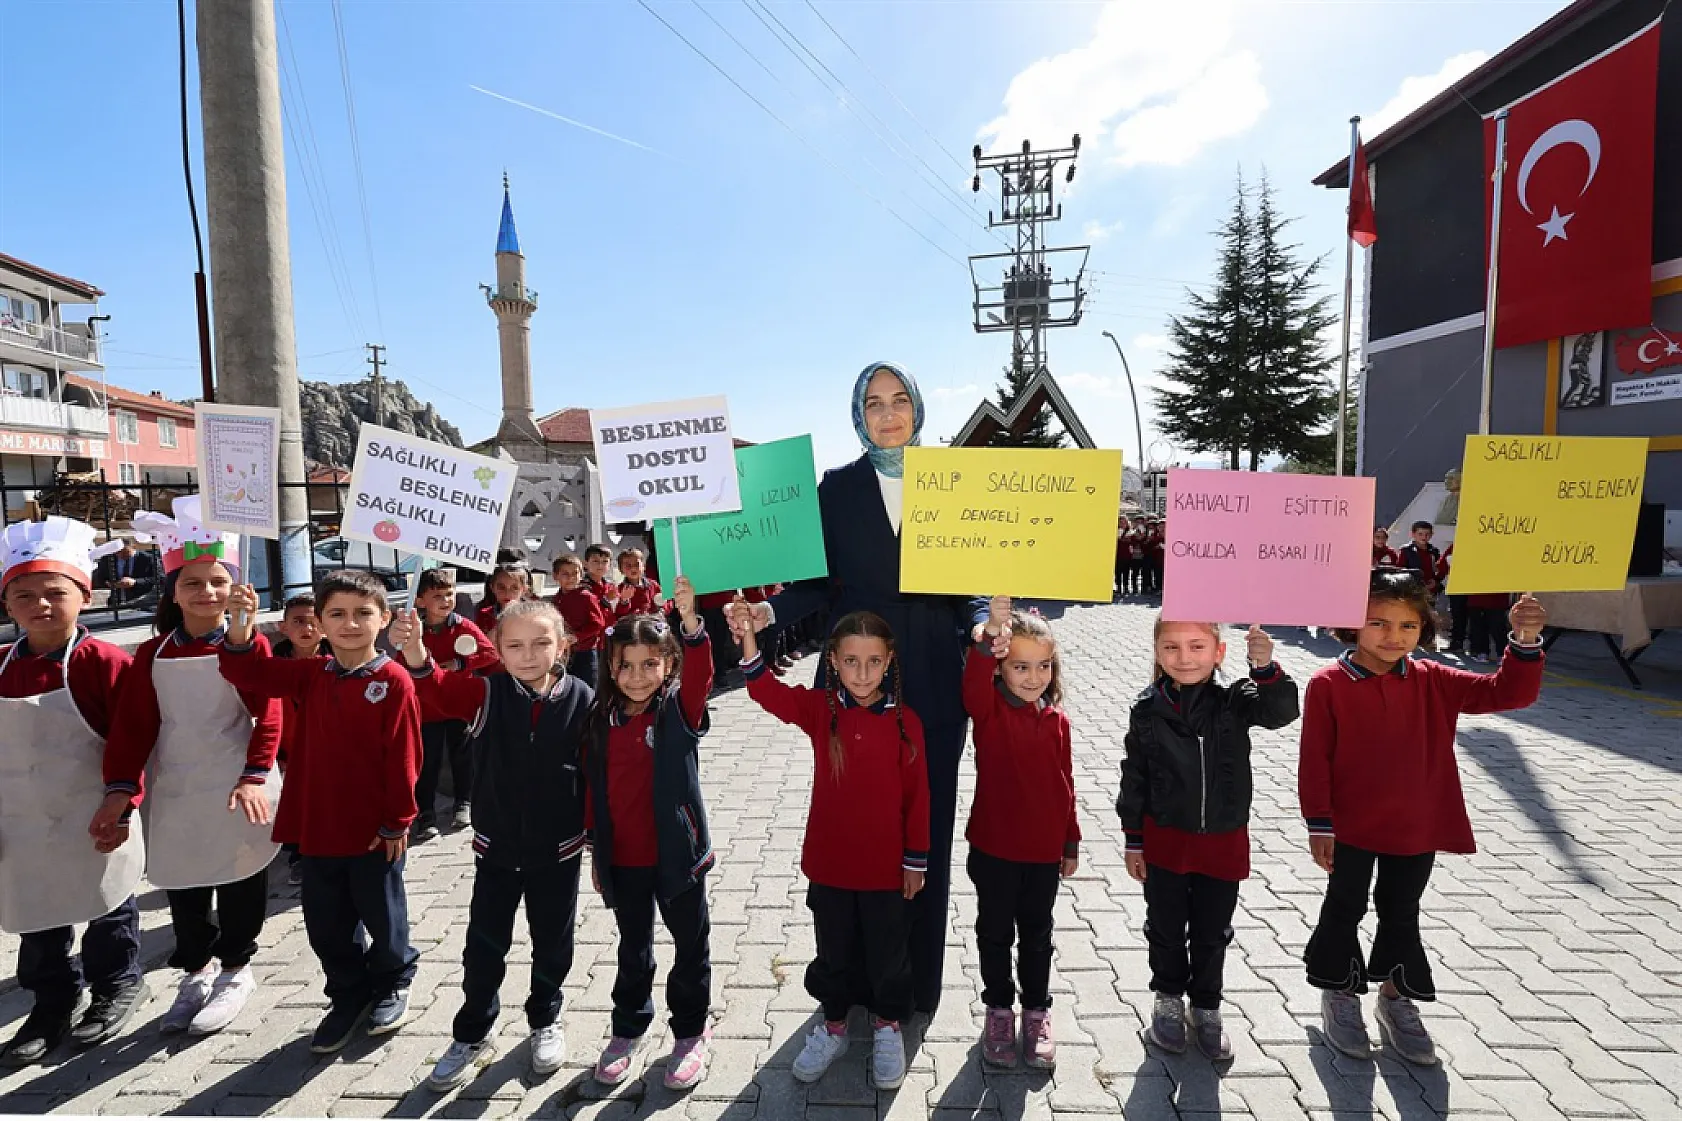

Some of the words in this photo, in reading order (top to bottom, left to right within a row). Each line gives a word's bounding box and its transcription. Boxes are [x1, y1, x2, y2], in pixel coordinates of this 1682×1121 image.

[600, 416, 727, 444] BESLENME
[28, 435, 86, 453] MARKET
[1484, 440, 1561, 461] SAĞLIKLI
[367, 440, 457, 478] SAĞLIKLI
[627, 446, 707, 470] DOSTU
[638, 475, 704, 496] OKUL
[916, 471, 961, 492] KALP
[986, 471, 1077, 493] SAĞLIĞINIZ
[1557, 477, 1639, 499] BESLENEN
[400, 476, 503, 517] BESLENEN
[761, 483, 800, 507] UZUN
[1174, 492, 1250, 513] KAHVALTI
[1284, 494, 1349, 516] EŞİTTİR
[356, 492, 446, 527] SAĞLIKLI
[960, 507, 1020, 524] DENGELİ
[1478, 513, 1537, 535] SAĞLIKLI
[424, 535, 492, 565] BÜYÜR
[1171, 540, 1237, 560] OKULDA
